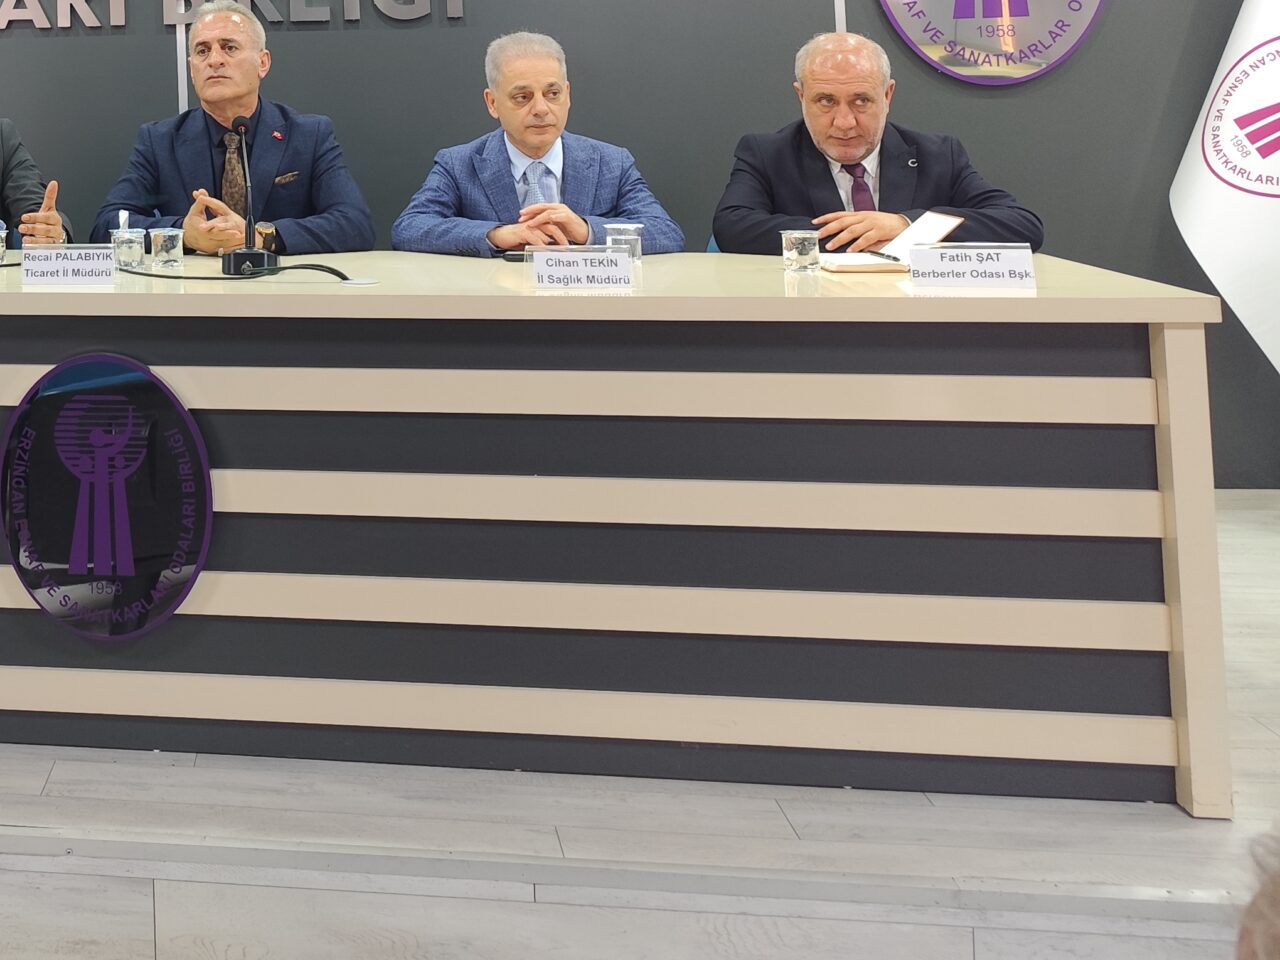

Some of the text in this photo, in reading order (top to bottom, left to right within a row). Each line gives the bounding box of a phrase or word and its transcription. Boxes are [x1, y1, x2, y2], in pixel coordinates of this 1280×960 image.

[976, 24, 1016, 38] 1958
[922, 21, 944, 44] VE
[944, 19, 1071, 67] SANATKARLAR
[1222, 69, 1250, 105] ESNAF
[1213, 108, 1225, 122] VE
[1230, 134, 1252, 159] 1958
[1211, 125, 1280, 187] SANATKARLARI
[23, 252, 113, 261] Recai PALABIYIK
[545, 256, 618, 267] Cihan TEKİN
[940, 252, 1001, 263] Fatih ŞAT
[24, 266, 111, 277] Ticaret İl Müdürü
[912, 269, 966, 279] Berberler
[970, 269, 1005, 279] Odası
[537, 273, 630, 286] İl Sağlık Müdürü
[12, 427, 36, 512] ERZİNCAN
[40, 576, 61, 597] VE
[170, 498, 196, 575] ODALARI
[88, 581, 122, 596] 1958
